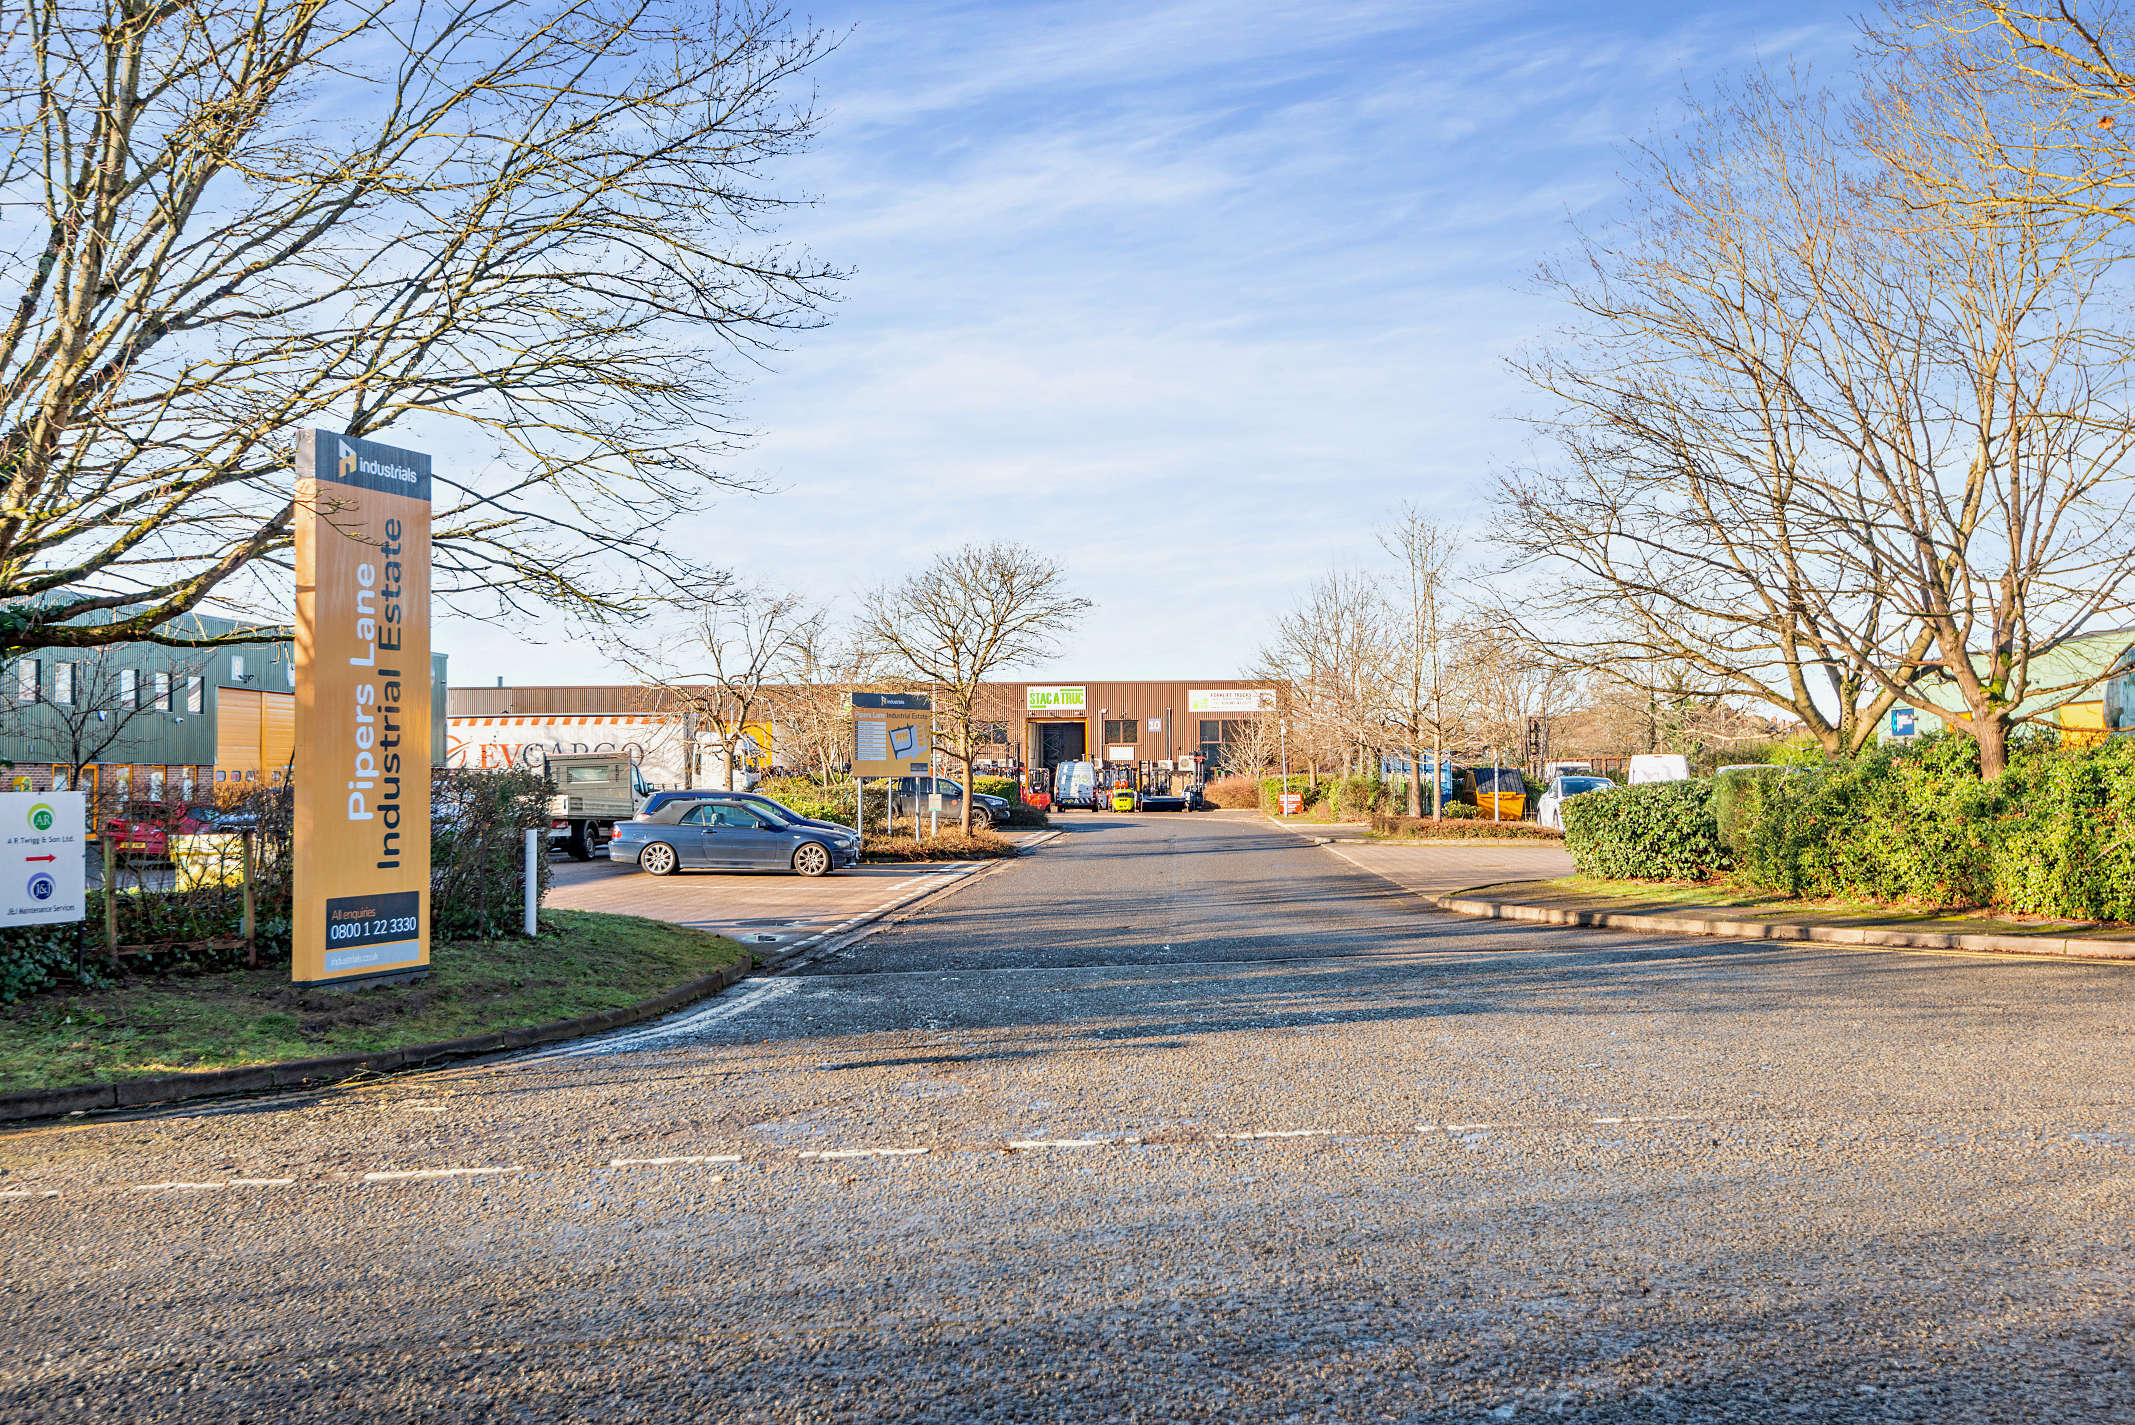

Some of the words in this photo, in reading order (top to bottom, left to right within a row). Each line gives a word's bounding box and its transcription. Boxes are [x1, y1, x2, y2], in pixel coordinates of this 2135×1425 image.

[359, 456, 418, 484] industrials
[378, 518, 402, 651] Estate
[350, 563, 375, 667] Lane
[1030, 692, 1052, 704] STAC
[1061, 692, 1084, 704] TRUC
[348, 684, 380, 820] Pipers
[377, 668, 401, 869] Industrial
[35, 814, 51, 826] AR
[20, 836, 40, 845] Twigg
[35, 883, 51, 898] J&J
[53, 904, 75, 912] Services
[331, 909, 343, 920] All
[343, 906, 377, 920] enquiries
[331, 923, 361, 940] 0800
[363, 921, 371, 936] 1
[373, 919, 388, 935] 22
[389, 916, 417, 933] 3330
